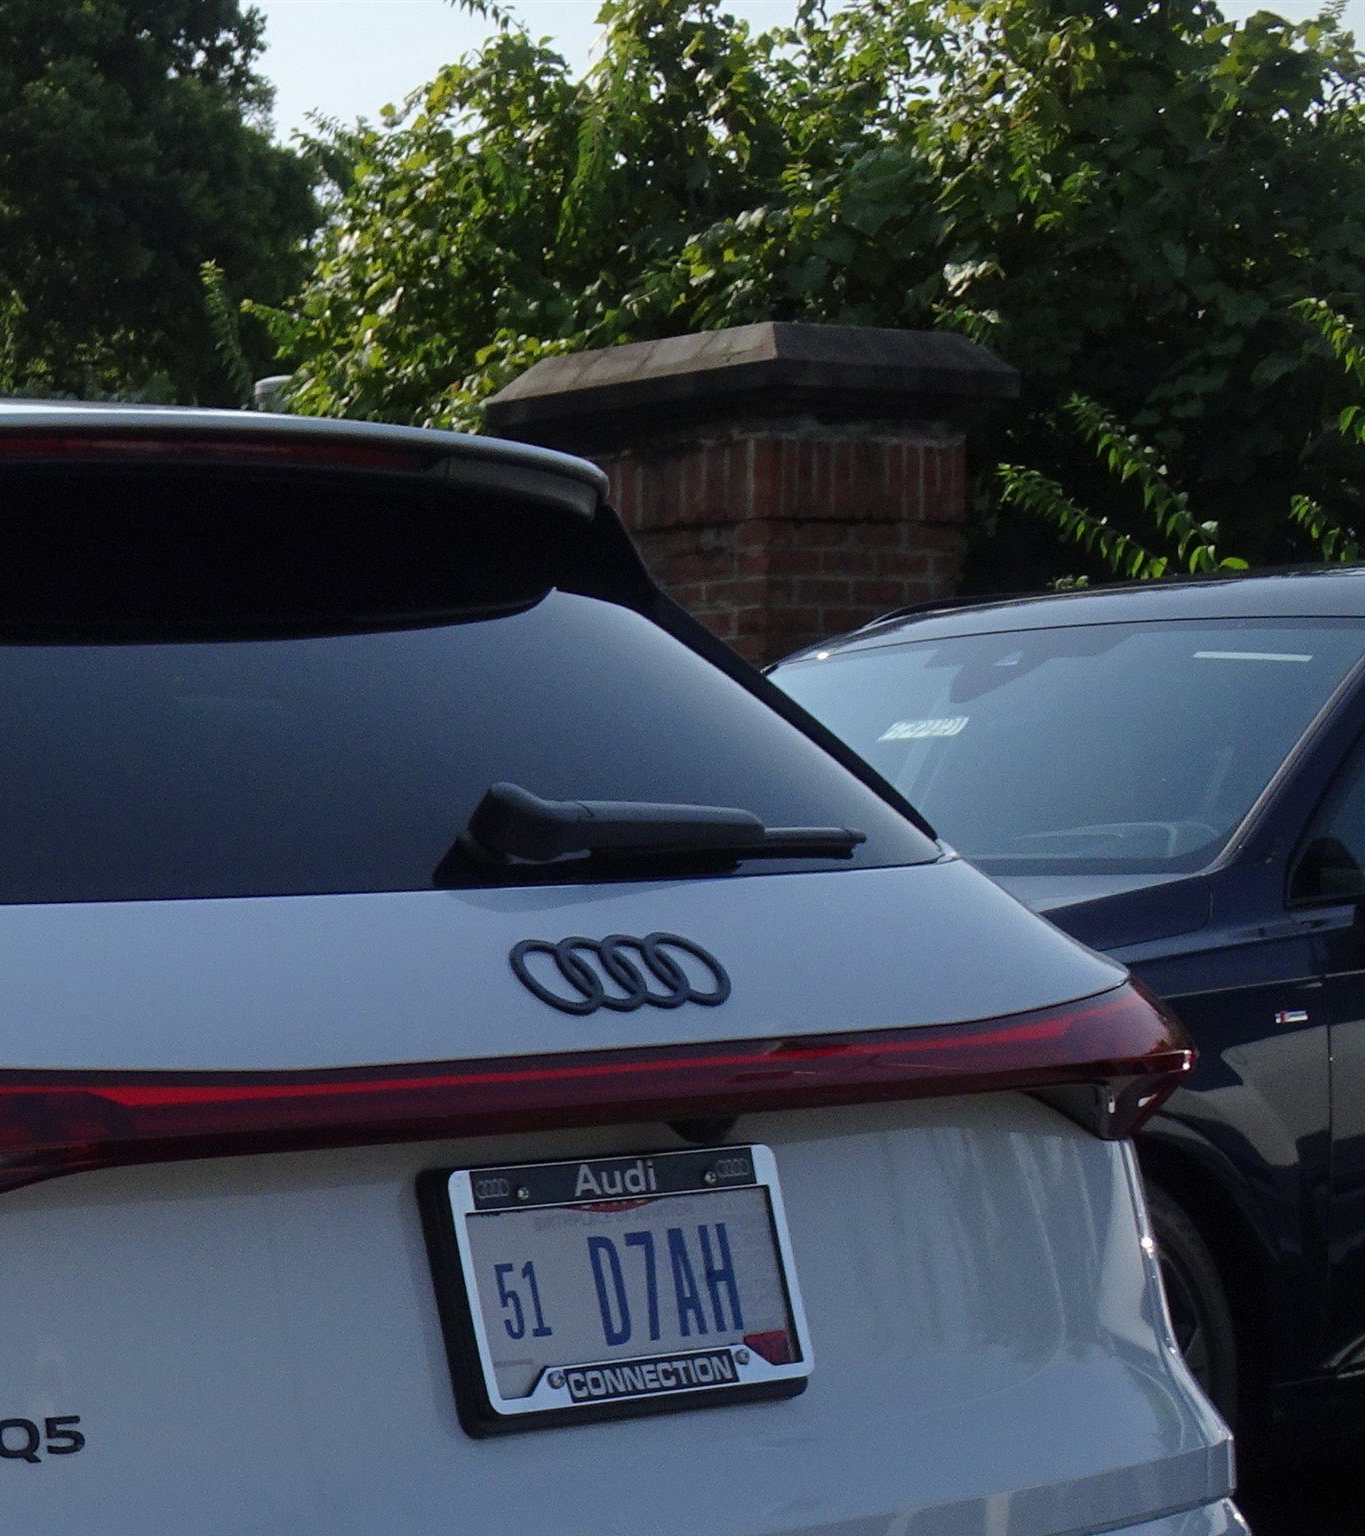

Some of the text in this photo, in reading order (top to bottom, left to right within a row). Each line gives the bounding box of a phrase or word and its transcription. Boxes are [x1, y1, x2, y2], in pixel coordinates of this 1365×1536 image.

[574, 1158, 657, 1197] Audi
[494, 1222, 744, 1347] 51 D7AH
[568, 1357, 734, 1399] CONNECTION
